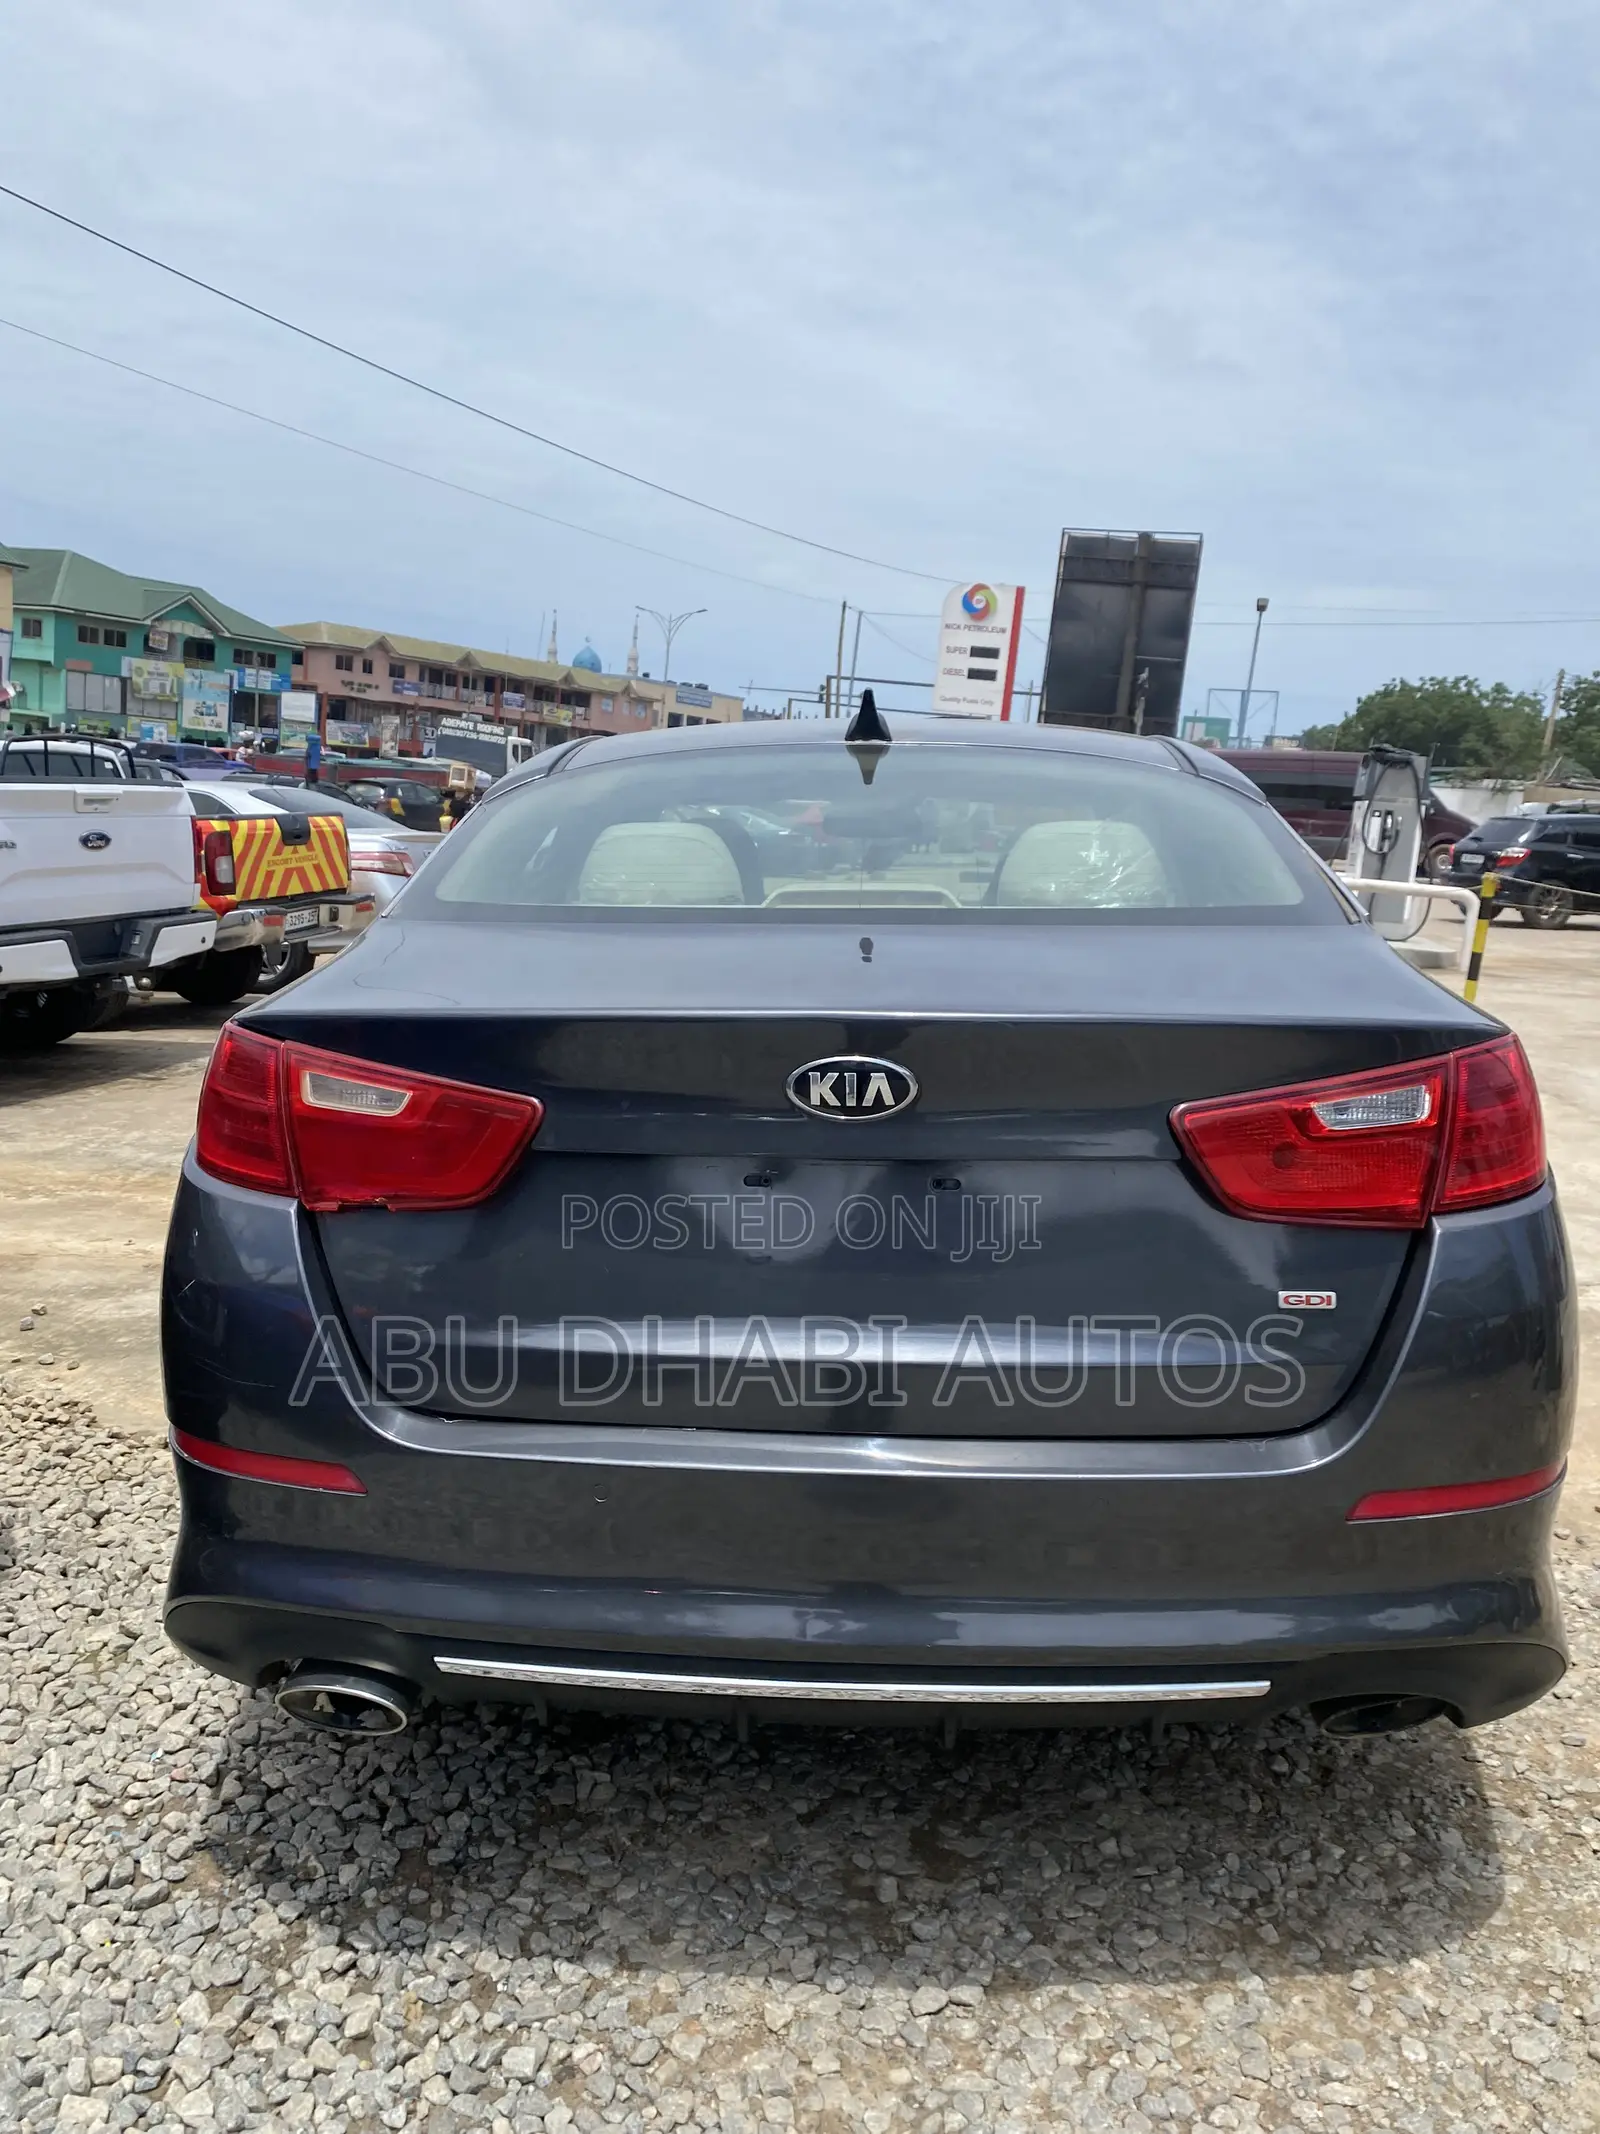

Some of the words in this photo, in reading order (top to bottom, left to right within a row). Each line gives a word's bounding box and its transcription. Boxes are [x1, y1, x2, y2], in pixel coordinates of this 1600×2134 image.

[963, 624, 1008, 634] PETROLEUM
[945, 645, 968, 655] SUPER
[942, 667, 966, 677] DIESEL
[267, 857, 293, 867] ESCORT
[294, 853, 319, 864] VEHICLE
[808, 1071, 896, 1107] KIA
[1283, 1294, 1333, 1306] GDI
